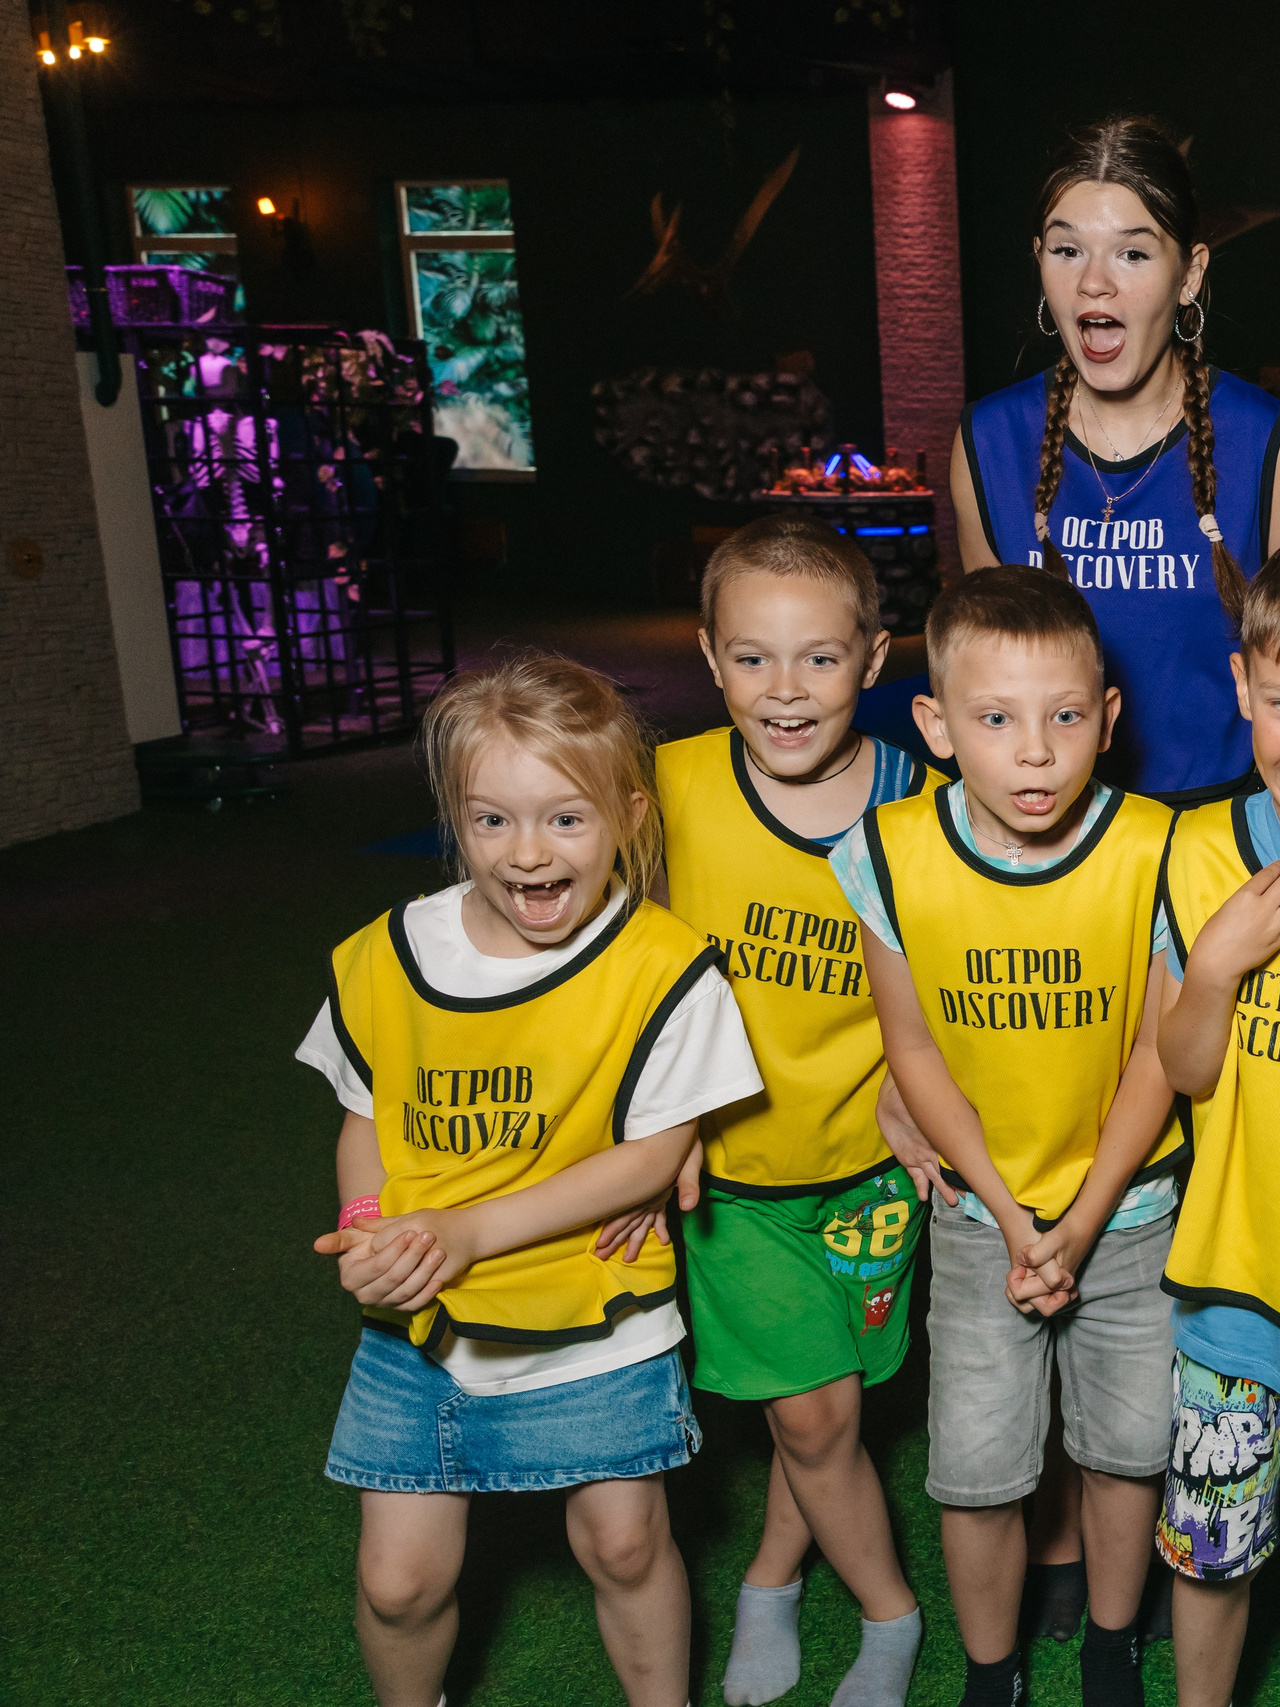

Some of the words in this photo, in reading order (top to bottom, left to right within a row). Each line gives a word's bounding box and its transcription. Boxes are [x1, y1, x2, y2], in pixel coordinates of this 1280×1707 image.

[1062, 516, 1164, 551] ОСТРОВ
[743, 901, 858, 954] ОСТРОВ
[966, 947, 1082, 985] ОСТРОВ
[938, 985, 1117, 1031] DISCOVERY
[416, 1065, 533, 1107] ОСТРОВ
[402, 1101, 559, 1155] DISCOVERY
